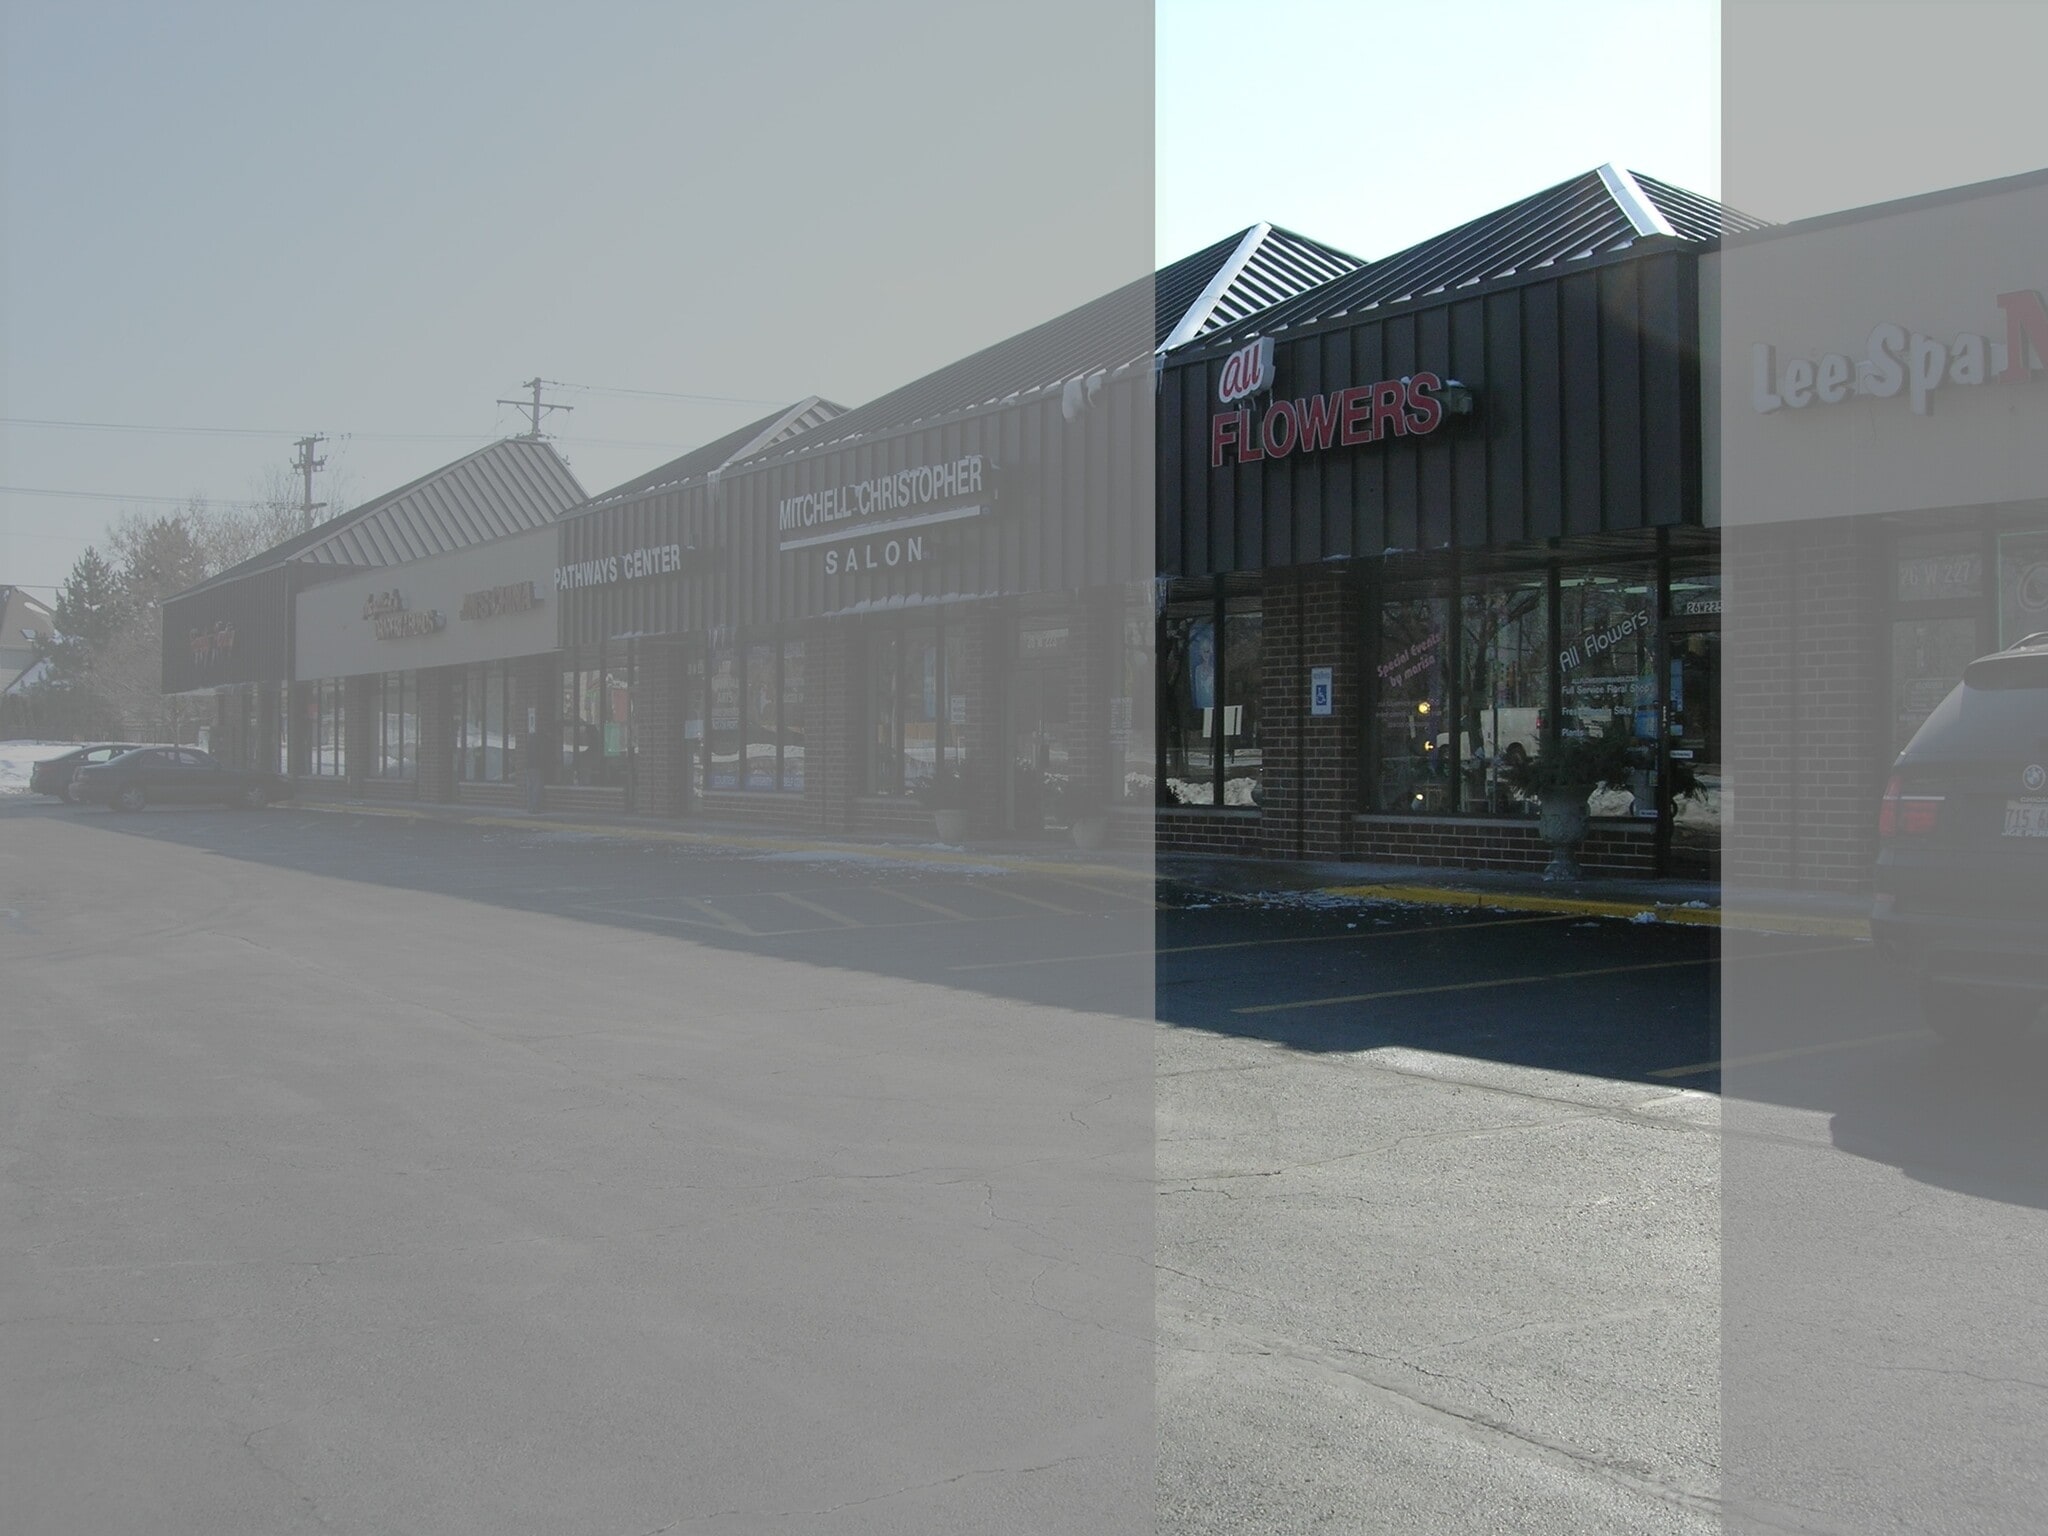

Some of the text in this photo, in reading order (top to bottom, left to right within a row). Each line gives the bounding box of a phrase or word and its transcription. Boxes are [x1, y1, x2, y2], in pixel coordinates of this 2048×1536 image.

[1752, 342, 1855, 414] Lee
[1866, 322, 1990, 416] Spa
[1212, 371, 1442, 467] FLOWERS
[778, 455, 983, 531] MITCHELL CHRISTOPHER
[553, 543, 681, 591] PATHWAYS CENTER
[825, 536, 922, 575] SALON
[1377, 634, 1440, 677] Special Events
[1560, 609, 1649, 672] All Flowers
[1389, 674, 1402, 687] by
[1561, 685, 1575, 695] Full
[1577, 684, 1604, 695] Service
[1606, 683, 1628, 694] Floral
